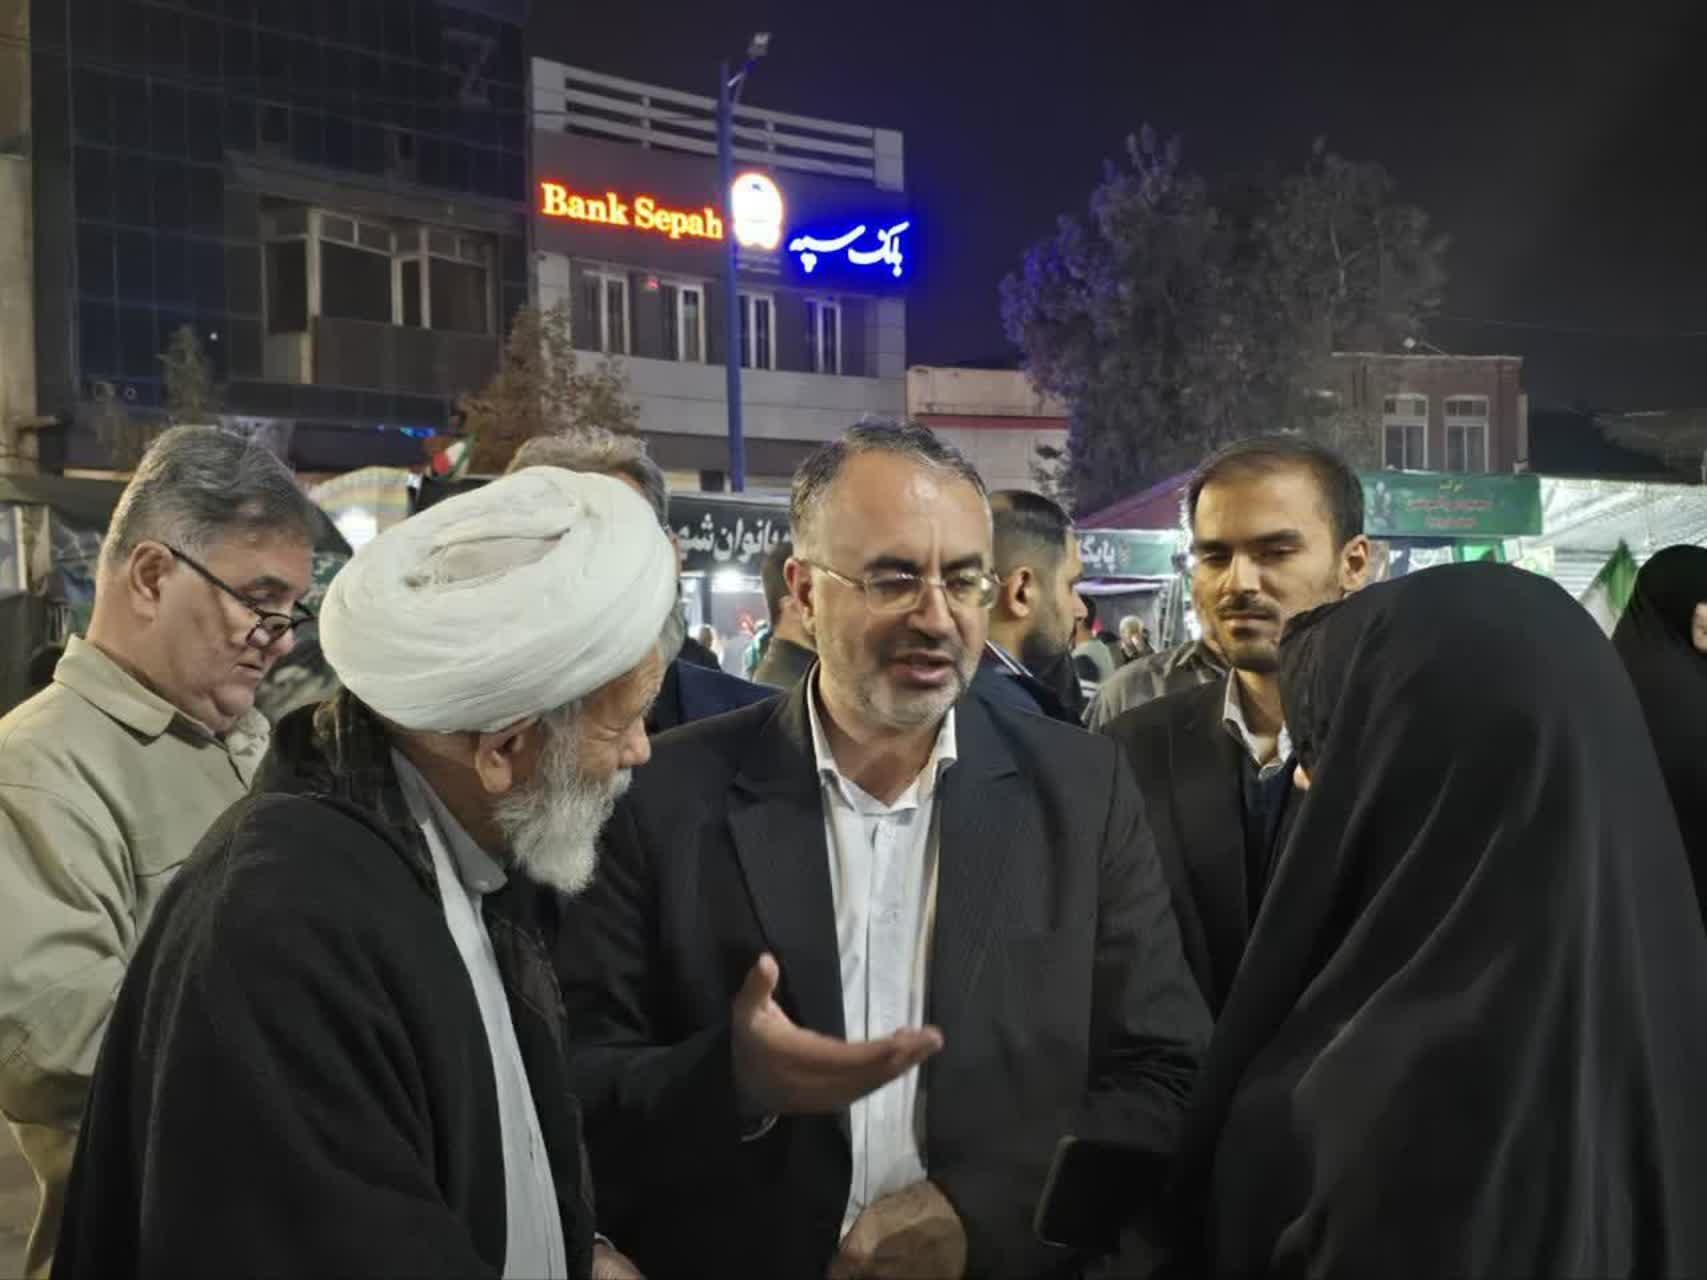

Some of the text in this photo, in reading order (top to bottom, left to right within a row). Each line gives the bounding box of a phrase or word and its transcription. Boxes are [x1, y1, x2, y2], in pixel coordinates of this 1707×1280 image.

[541, 182, 724, 240] Bank Sepah
[788, 221, 910, 277] بانک سپه
